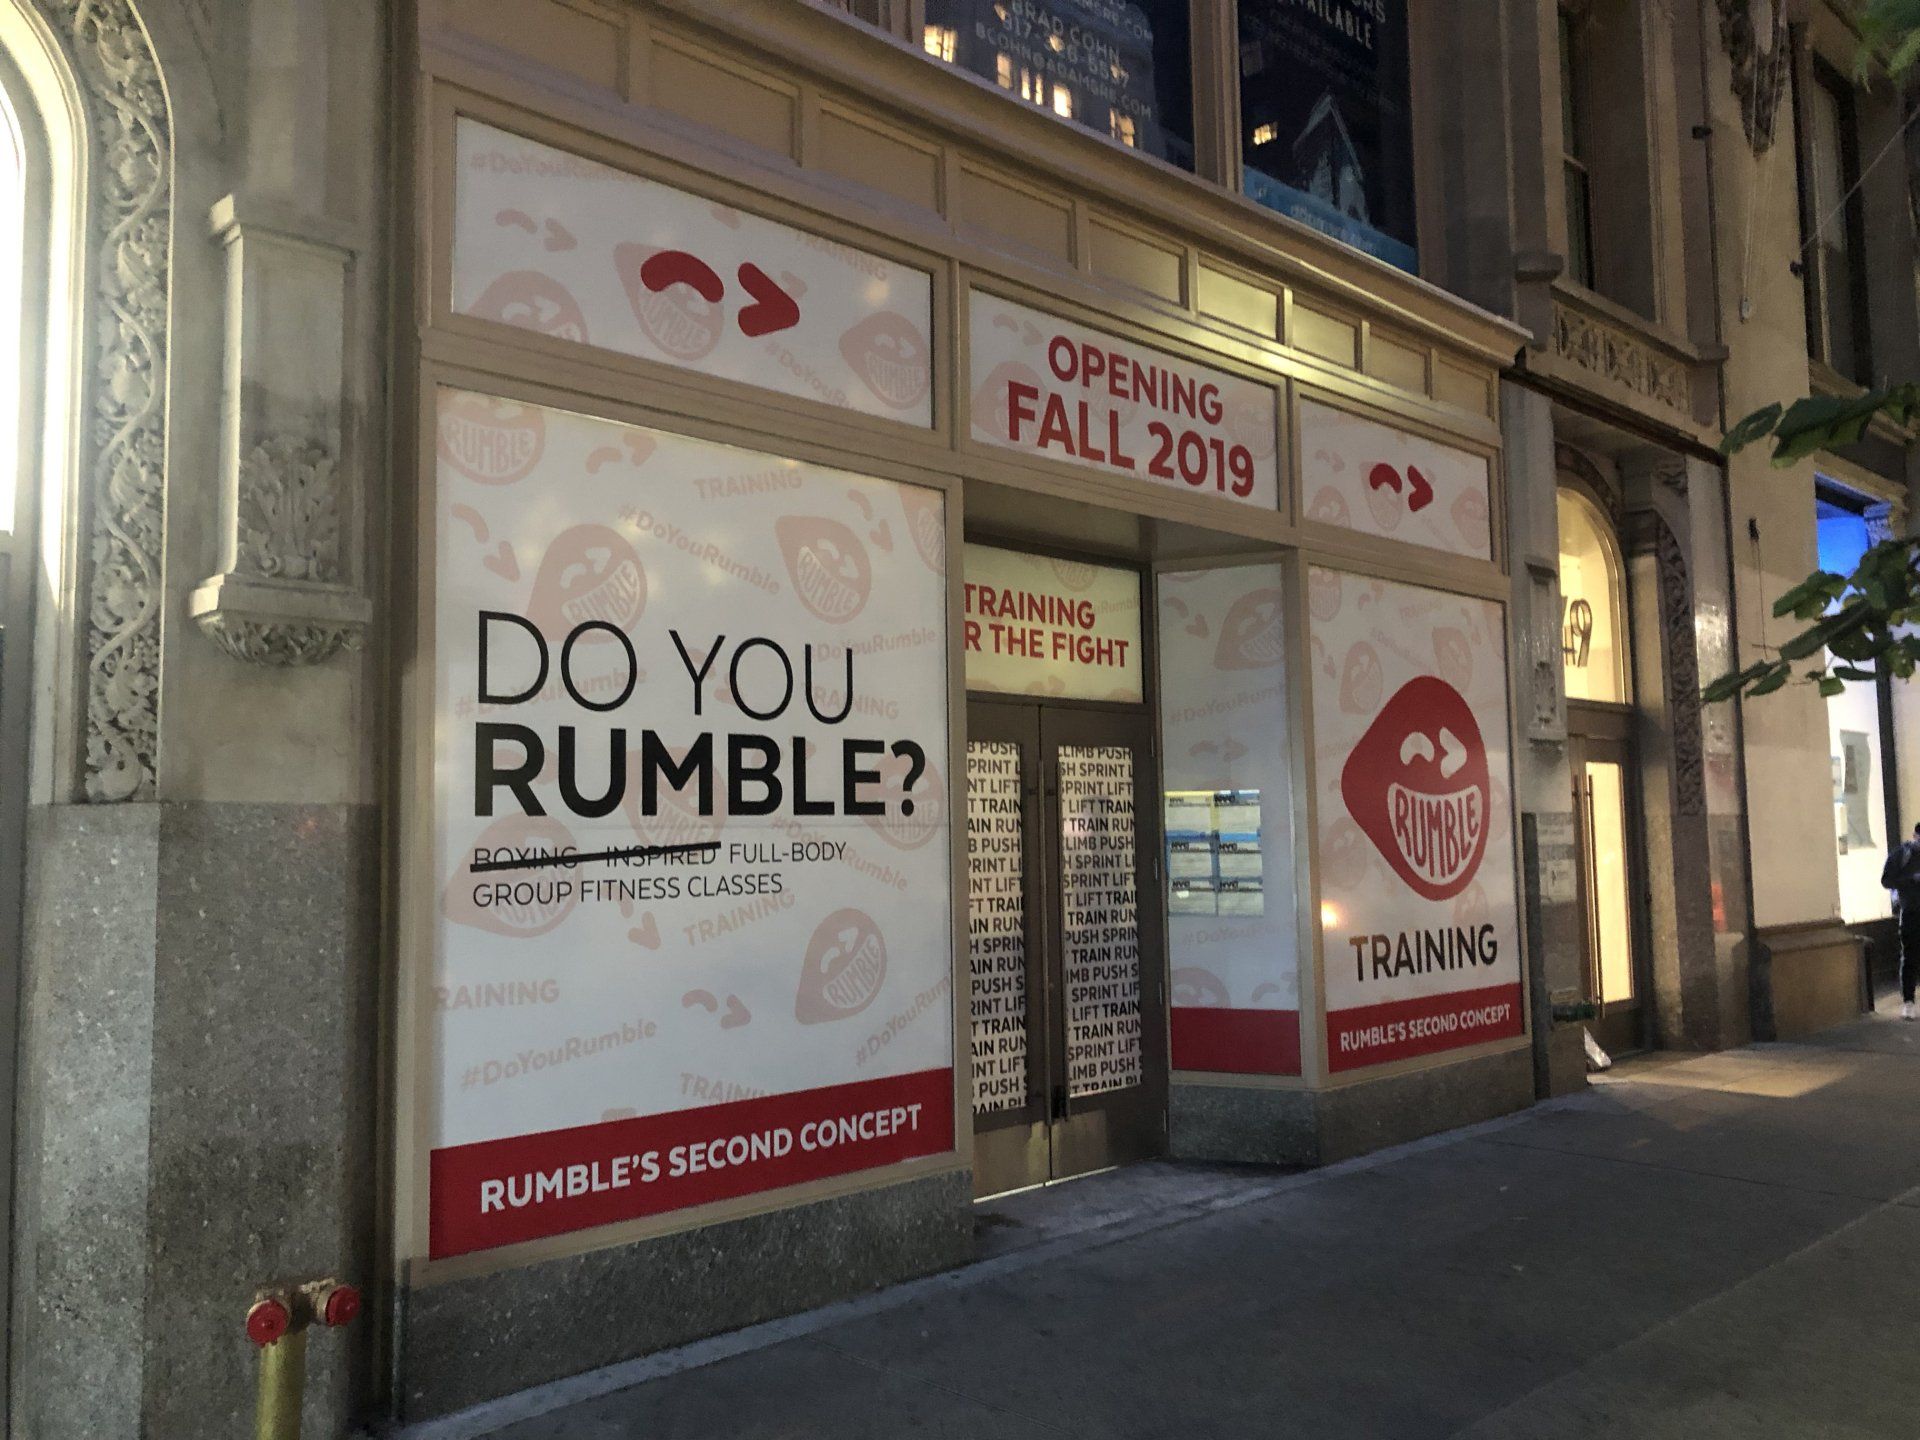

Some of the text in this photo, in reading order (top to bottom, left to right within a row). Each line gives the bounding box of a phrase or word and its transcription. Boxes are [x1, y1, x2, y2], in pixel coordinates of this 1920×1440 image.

[1048, 335, 1223, 425] OPENING
[446, 421, 531, 474] RUMBLE
[1008, 380, 1135, 470] FALL
[1147, 421, 1254, 498] 2019
[693, 470, 801, 499] TRAINING
[618, 503, 780, 595] #DoYouRumble
[800, 551, 857, 613] RUMBLE
[964, 583, 1095, 630] TRAINING
[989, 623, 1044, 659] THE
[1052, 631, 1129, 667] FIGHT
[478, 610, 854, 725] DO YOU
[1098, 746, 1132, 760] PUSH
[474, 721, 926, 818] RUMBLE?
[1080, 763, 1125, 777] SPRINT
[990, 779, 1020, 794] LIFT
[1107, 782, 1133, 796] LIFT
[980, 799, 1021, 814] TRAIN
[1069, 800, 1135, 814] LIFT TRAIN
[996, 818, 1021, 833] RUN
[1070, 818, 1135, 832] TRAIN RUN
[1396, 788, 1479, 878] RUMBLE
[981, 838, 1020, 853] PUSH
[1101, 836, 1134, 850] PUSH
[471, 841, 848, 870] BOXING INSPIRED FULL-BODY
[1076, 854, 1121, 869] SPRINT
[472, 881, 573, 908] GROUP
[581, 876, 681, 903] FITNESS
[687, 872, 783, 898] CLASSES
[1063, 873, 1110, 888] SPRINT
[1076, 892, 1104, 907] LIFT
[682, 887, 796, 947] TRAINING
[993, 916, 1023, 932] RUN
[1068, 908, 1137, 926] TRAIN RUN
[1072, 945, 1139, 964] TRAIN RUN
[1349, 923, 1498, 982] TRAINING
[997, 956, 1025, 972] RUN
[1093, 965, 1128, 981] PUSH
[826, 942, 880, 1006] RUMBLE
[972, 977, 1011, 995] PUSH
[1072, 984, 1119, 1003] SPRINT
[1072, 1000, 1140, 1022] LIFT TRAIN
[982, 1015, 1026, 1035] TRAIN
[1074, 1023, 1113, 1041] TRAIN
[1340, 1003, 1511, 1053] RUMBLE'S SECOND CONCEPT
[999, 1036, 1026, 1053] RUN
[1068, 1041, 1114, 1061] SPRINT
[461, 1019, 657, 1091] #DoYouRumble
[1101, 1057, 1135, 1076] PUSH
[979, 1077, 1019, 1098] PUSH
[481, 1103, 922, 1214] RUMBLE'S SECOND CONCEPT
